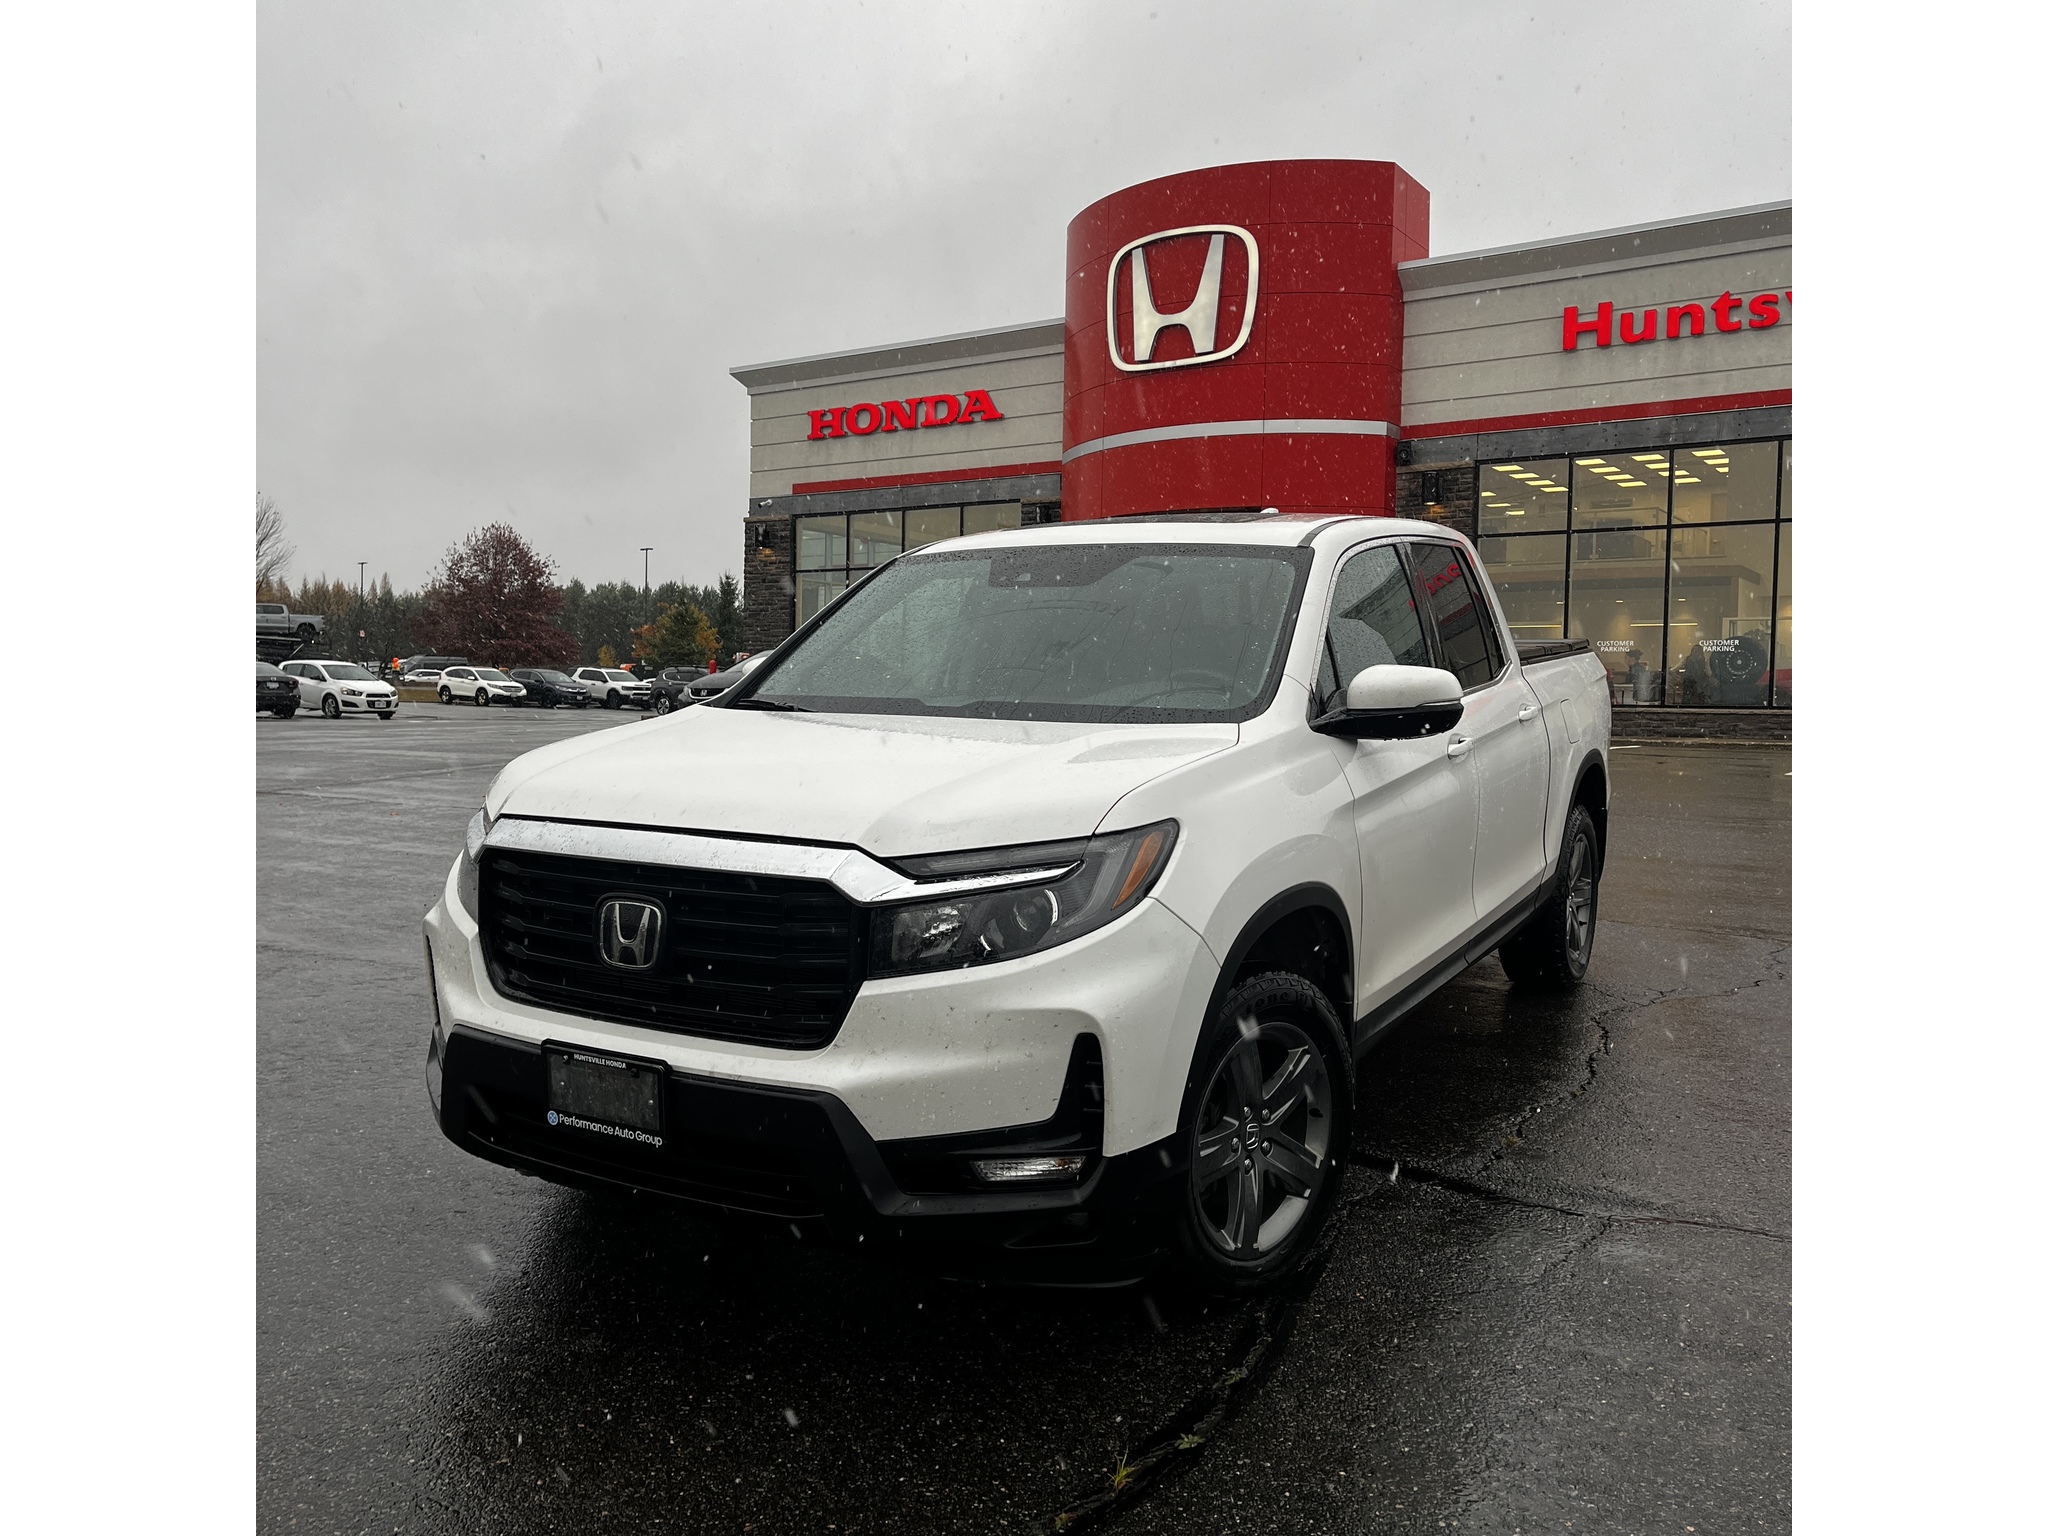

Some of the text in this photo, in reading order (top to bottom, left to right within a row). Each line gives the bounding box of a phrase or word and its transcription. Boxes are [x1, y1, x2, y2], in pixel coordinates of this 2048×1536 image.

[807, 388, 1004, 441] HONDA
[1702, 645, 1735, 653] PARKING
[573, 1053, 627, 1069] HUNTSVILLE HONDA
[559, 1113, 663, 1148] Performance Auto Group
